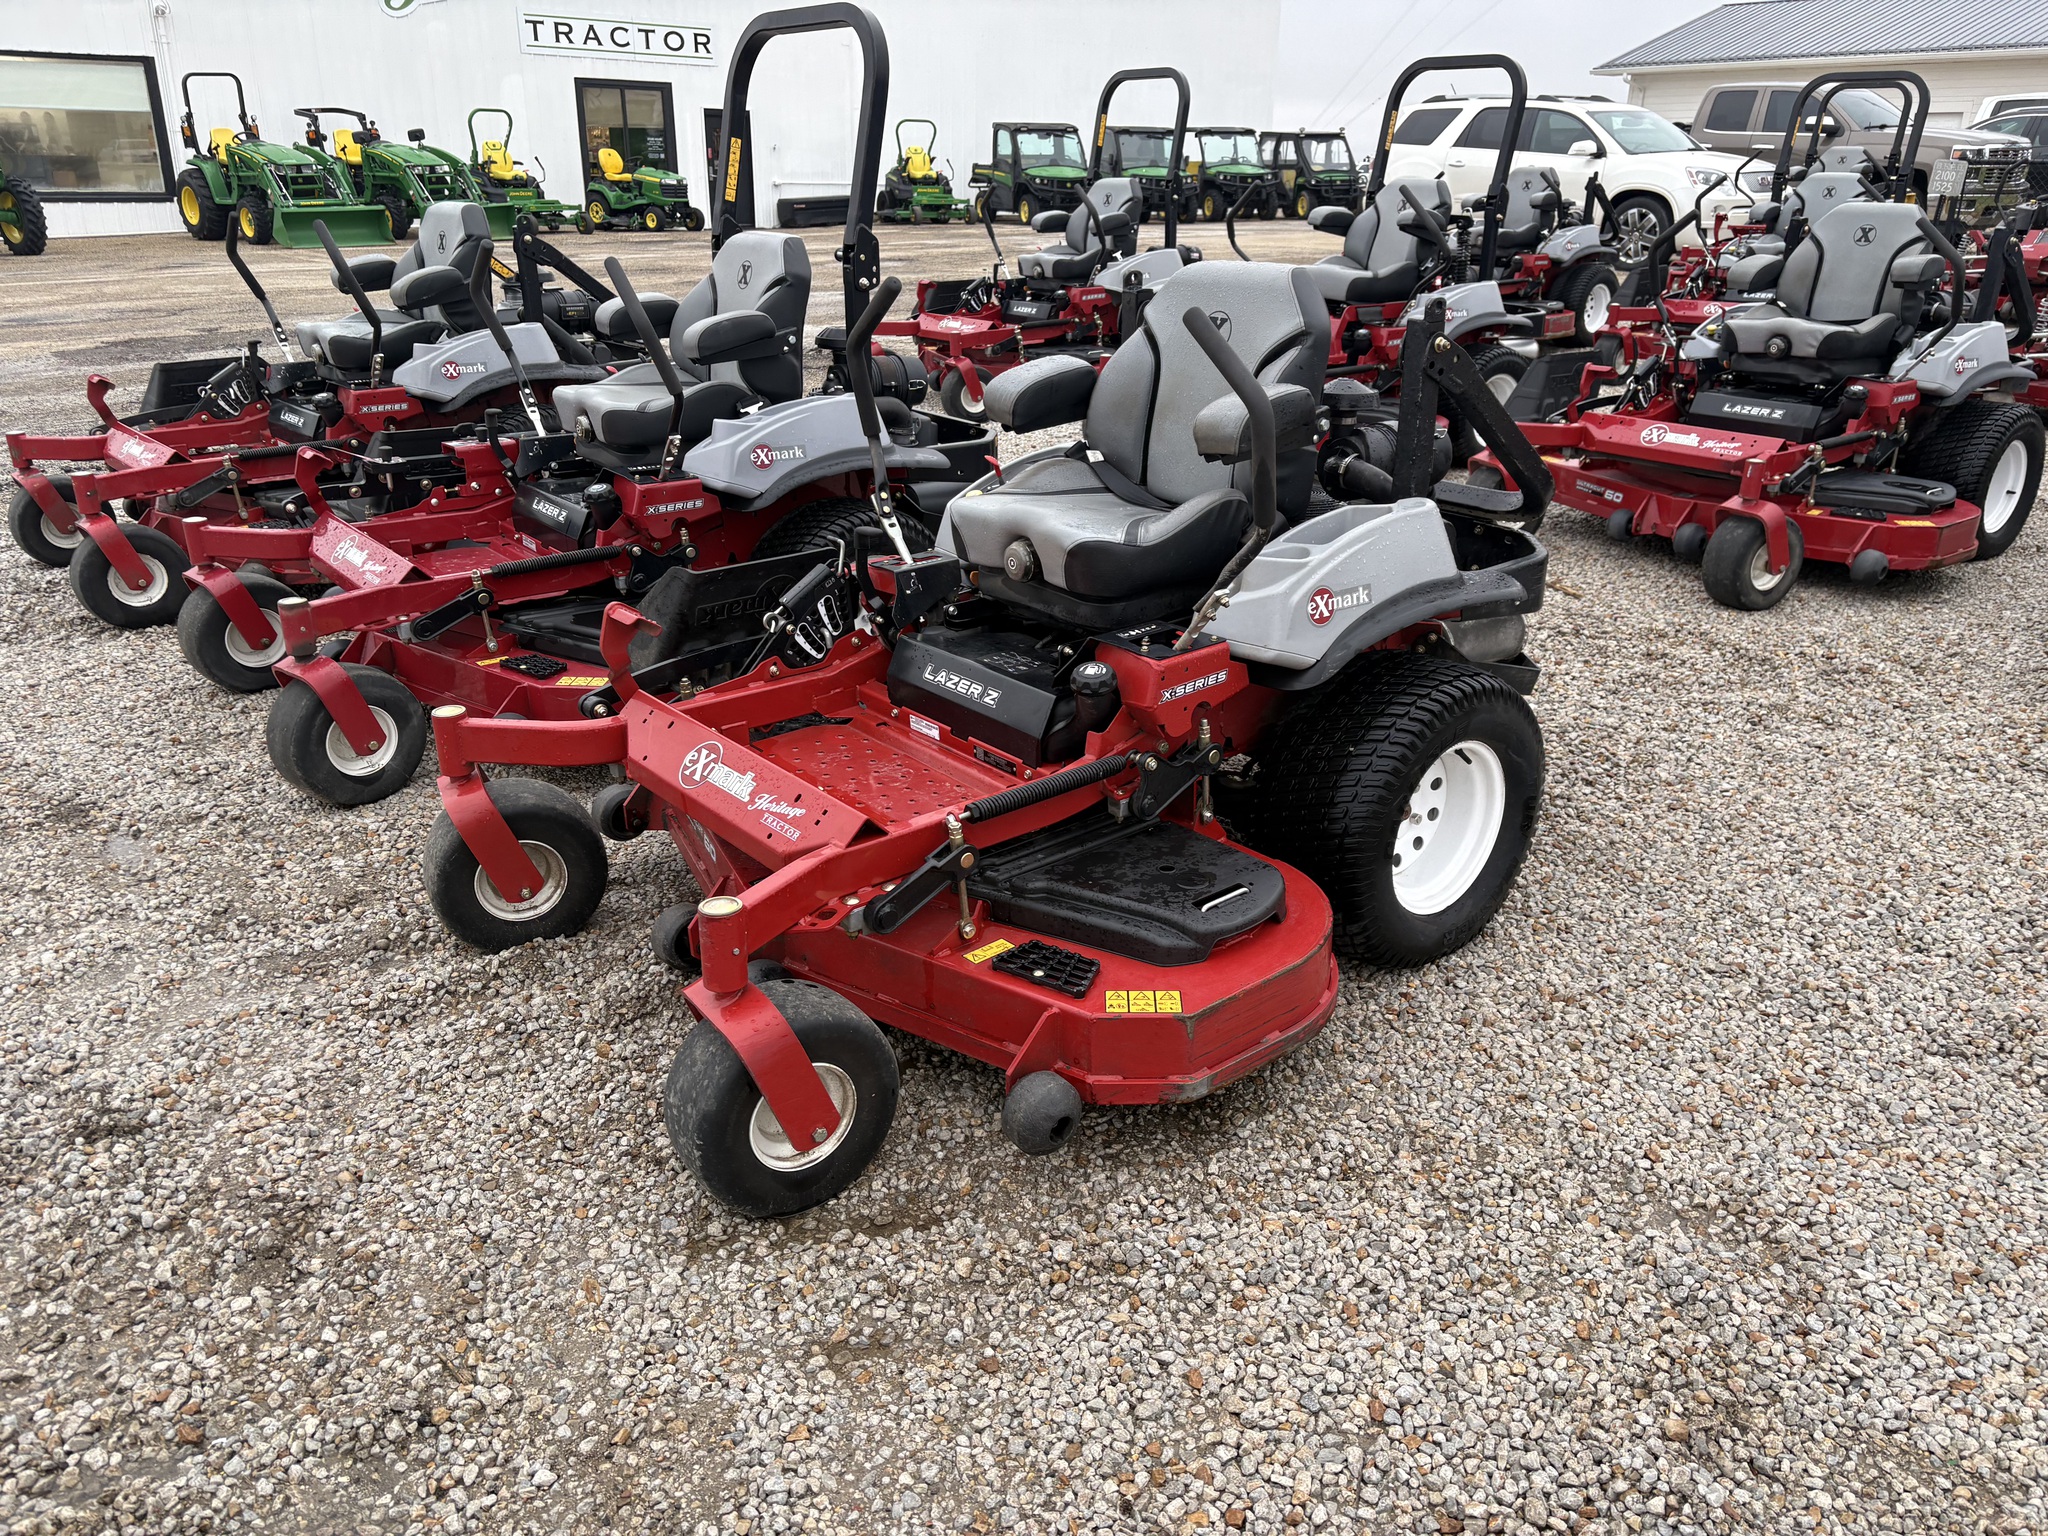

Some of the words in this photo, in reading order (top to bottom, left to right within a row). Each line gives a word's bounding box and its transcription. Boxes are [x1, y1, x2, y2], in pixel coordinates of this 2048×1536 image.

[525, 19, 712, 54] TRACTOR
[1935, 170, 1956, 181] 2100
[1932, 181, 1953, 193] 1525
[1446, 309, 1468, 321] Xmark
[441, 361, 486, 378] eXmark
[280, 410, 300, 425] LAZER
[1722, 402, 1767, 416] LAZER
[1768, 408, 1787, 420] Z
[750, 446, 805, 466] eXmark
[1604, 489, 1624, 503] 60
[532, 498, 560, 520] LAZER
[558, 509, 568, 523] Z
[1307, 586, 1369, 620] eXmark
[923, 663, 984, 702] LAZER
[981, 687, 1002, 708] Z
[679, 742, 757, 803] eXmark
[747, 793, 807, 820] Heritage
[761, 813, 800, 841] TRACTOR
